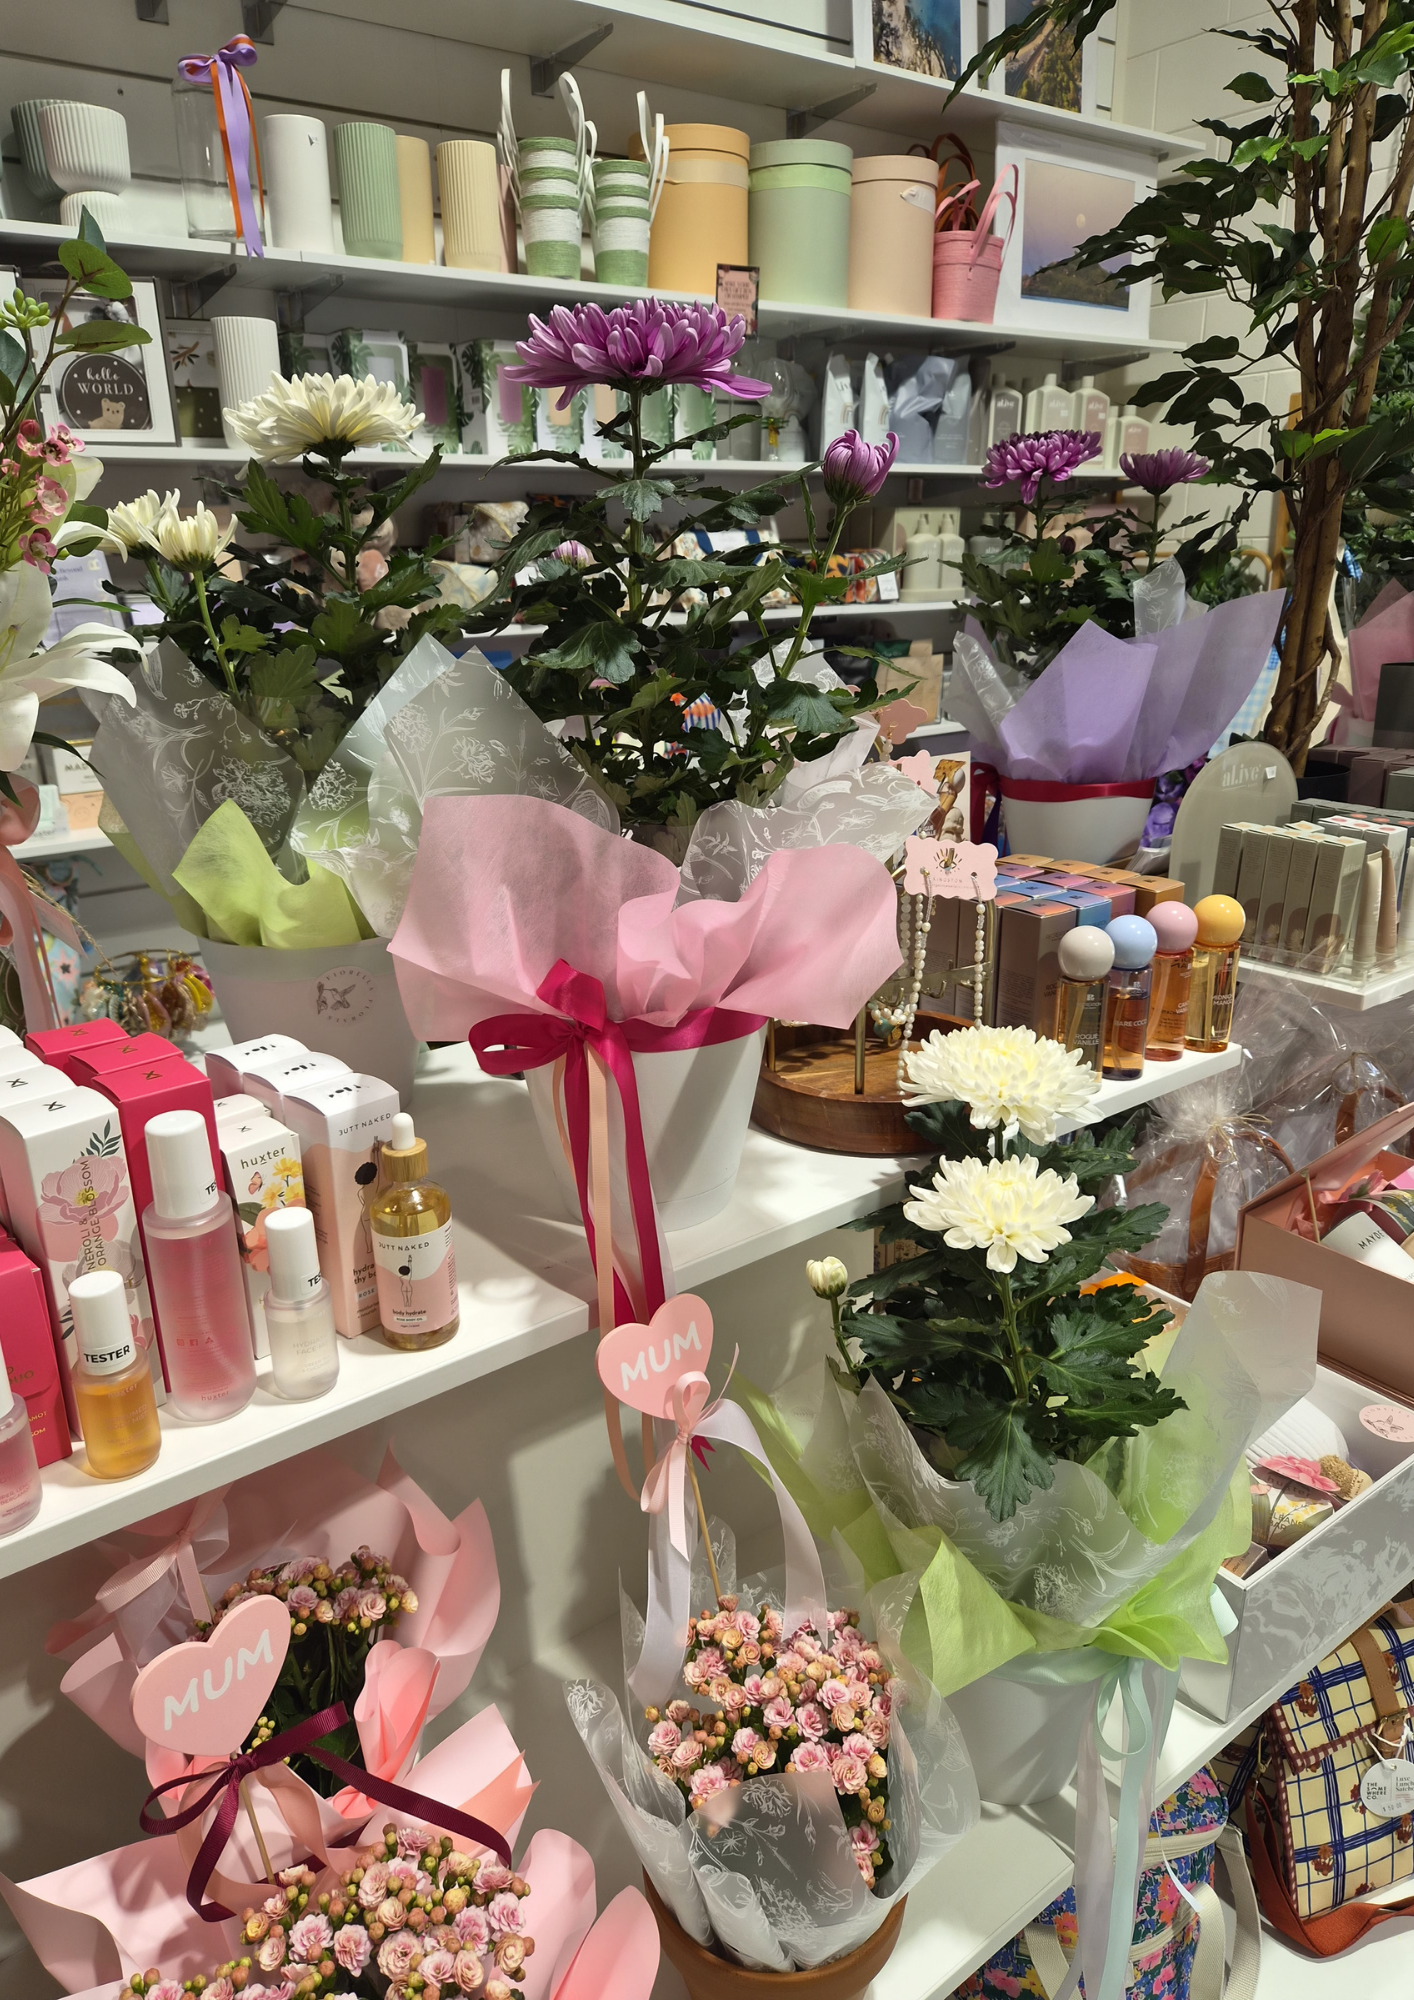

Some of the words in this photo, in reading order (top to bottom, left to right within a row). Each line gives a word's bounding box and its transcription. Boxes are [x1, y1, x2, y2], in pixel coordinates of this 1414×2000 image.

[86, 366, 120, 381] hello
[77, 382, 134, 395] WORLD
[361, 1112, 391, 1128] NAKED
[240, 1146, 286, 1169] huxter
[80, 1160, 97, 1215] BLOSSOM
[81, 1229, 96, 1270] NEROLI
[91, 1217, 106, 1266] ORANGE
[398, 1241, 430, 1251] NAKED
[353, 1263, 375, 1276] hydra
[354, 1275, 367, 1284] thy
[405, 1309, 427, 1317] hydrate
[83, 1344, 131, 1364] TESTER
[620, 1319, 703, 1392] MUM
[162, 1628, 275, 1732] MUM
